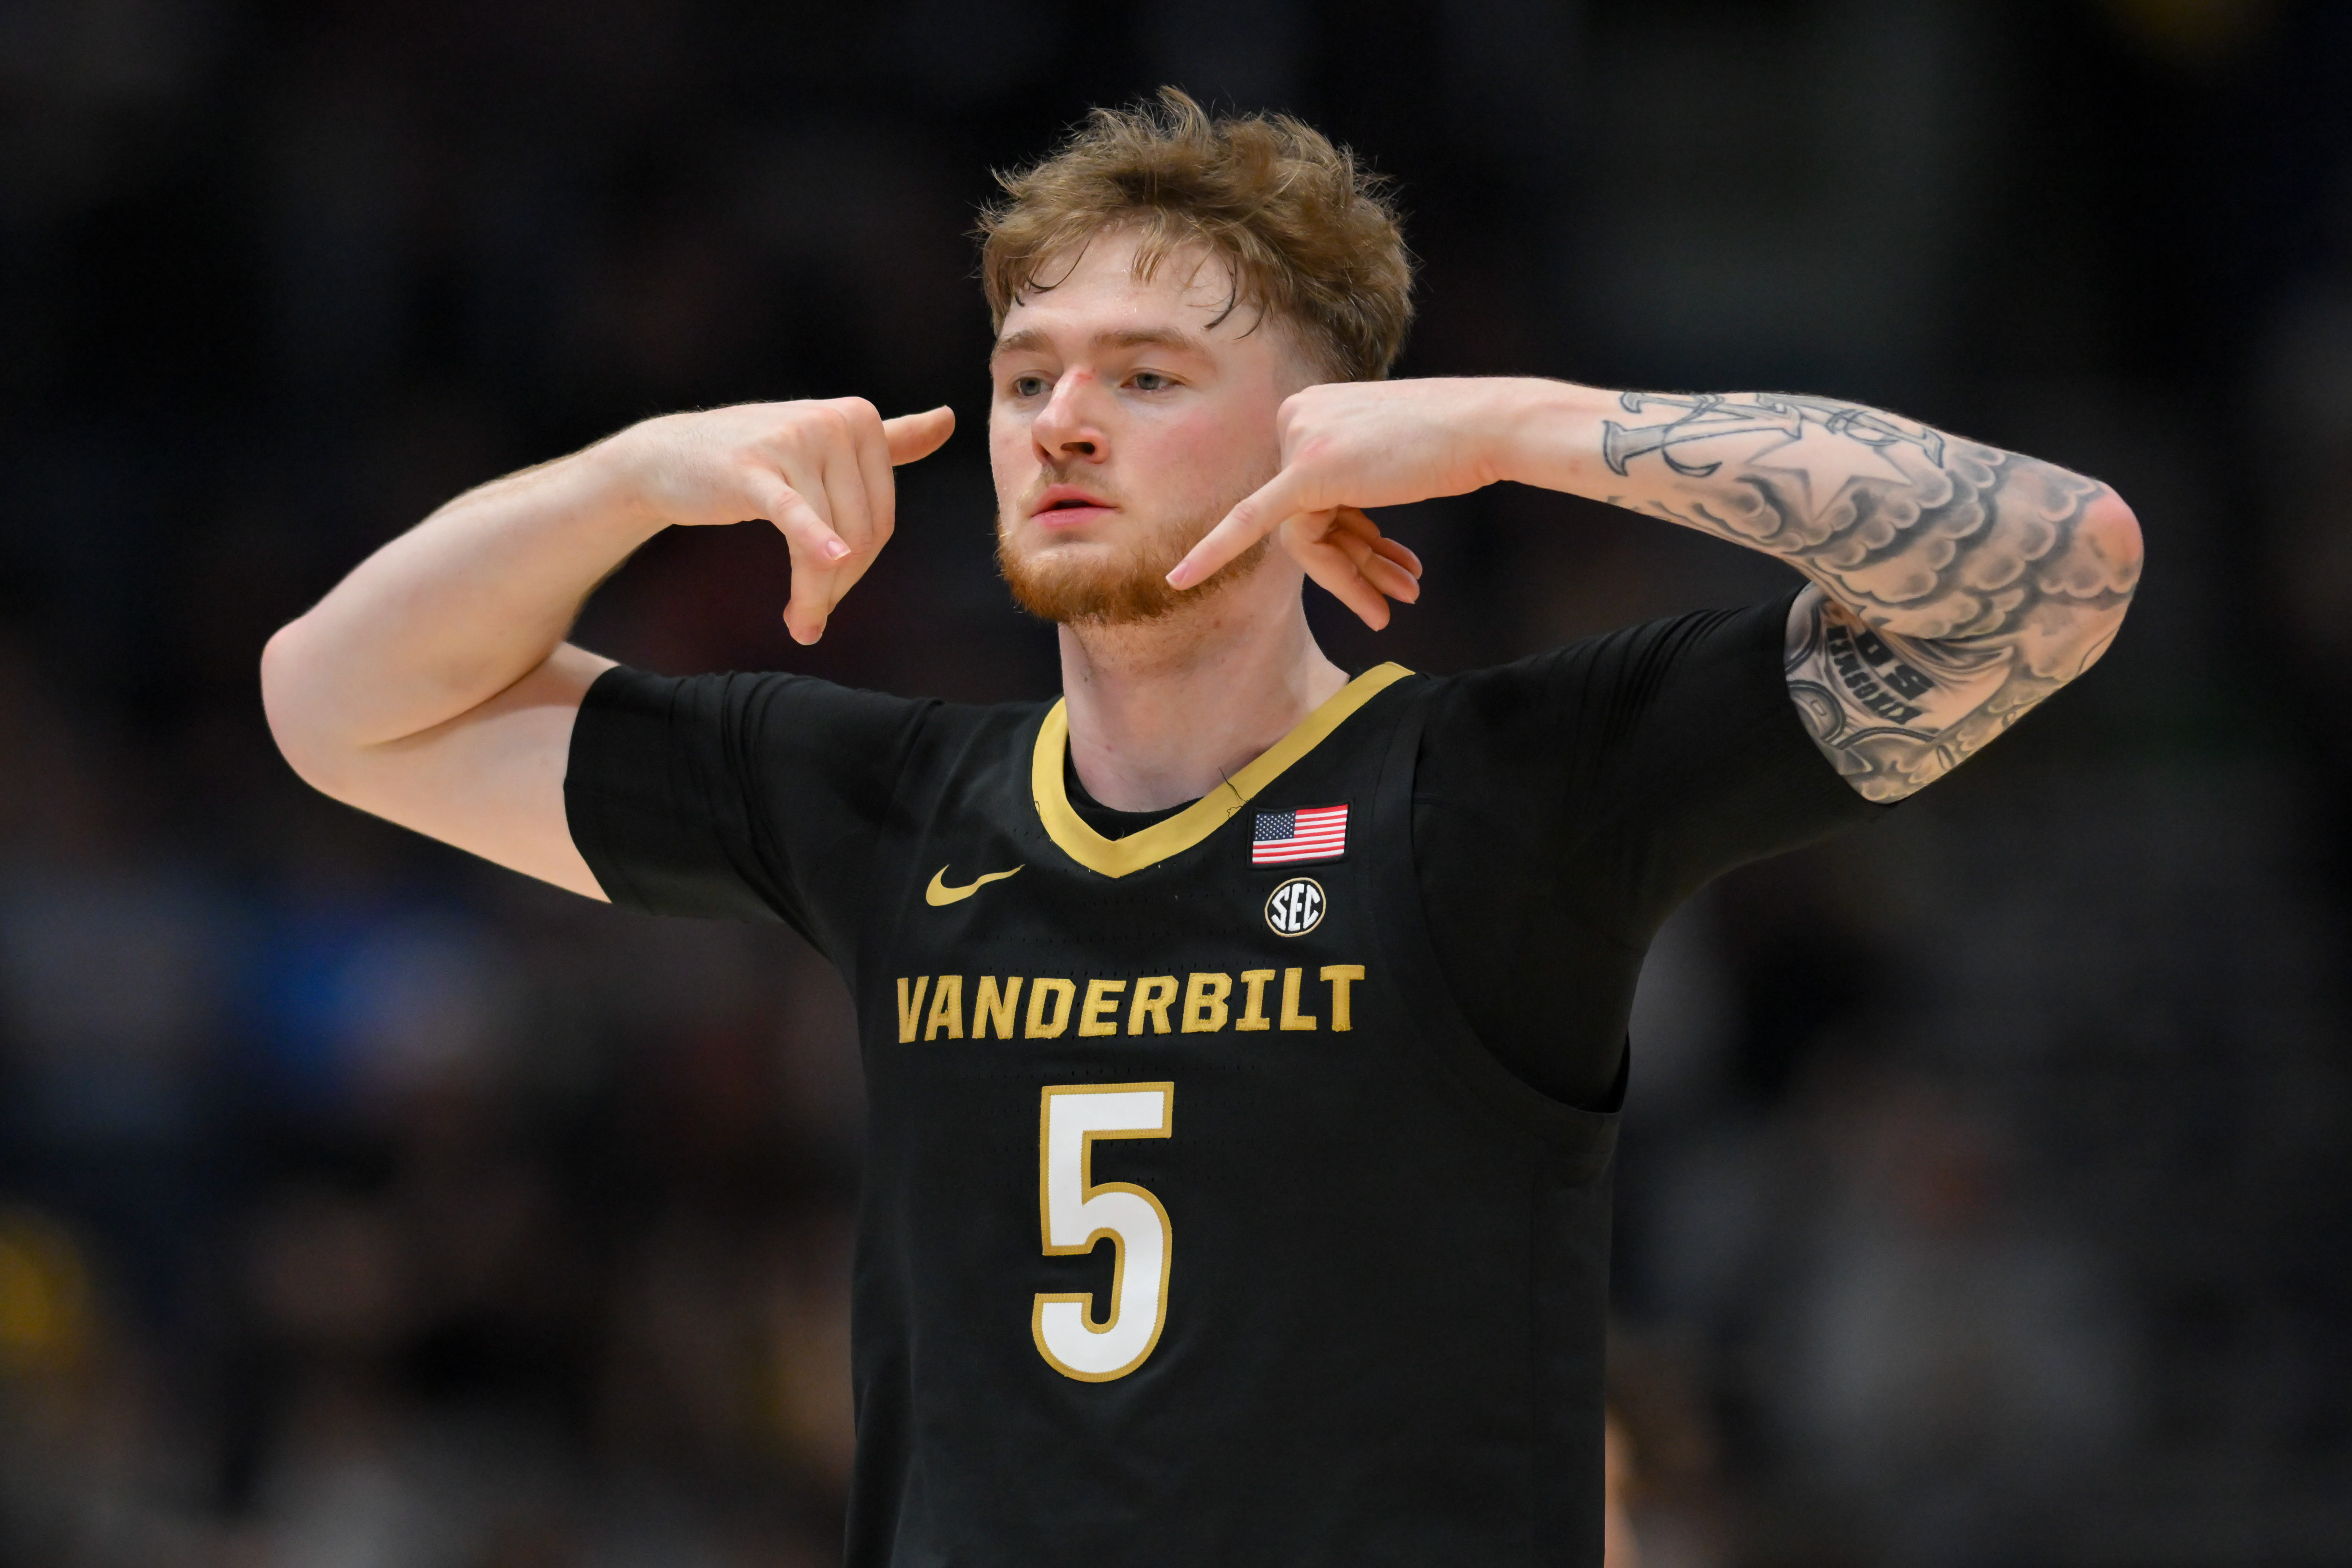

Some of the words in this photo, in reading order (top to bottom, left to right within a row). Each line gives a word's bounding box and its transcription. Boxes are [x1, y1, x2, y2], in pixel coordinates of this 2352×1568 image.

[1826, 626, 1924, 725] KINGSMEN
[1271, 883, 1321, 931] SEC
[897, 965, 1365, 1043] VANDERBILT
[1032, 1082, 1174, 1383] 5
